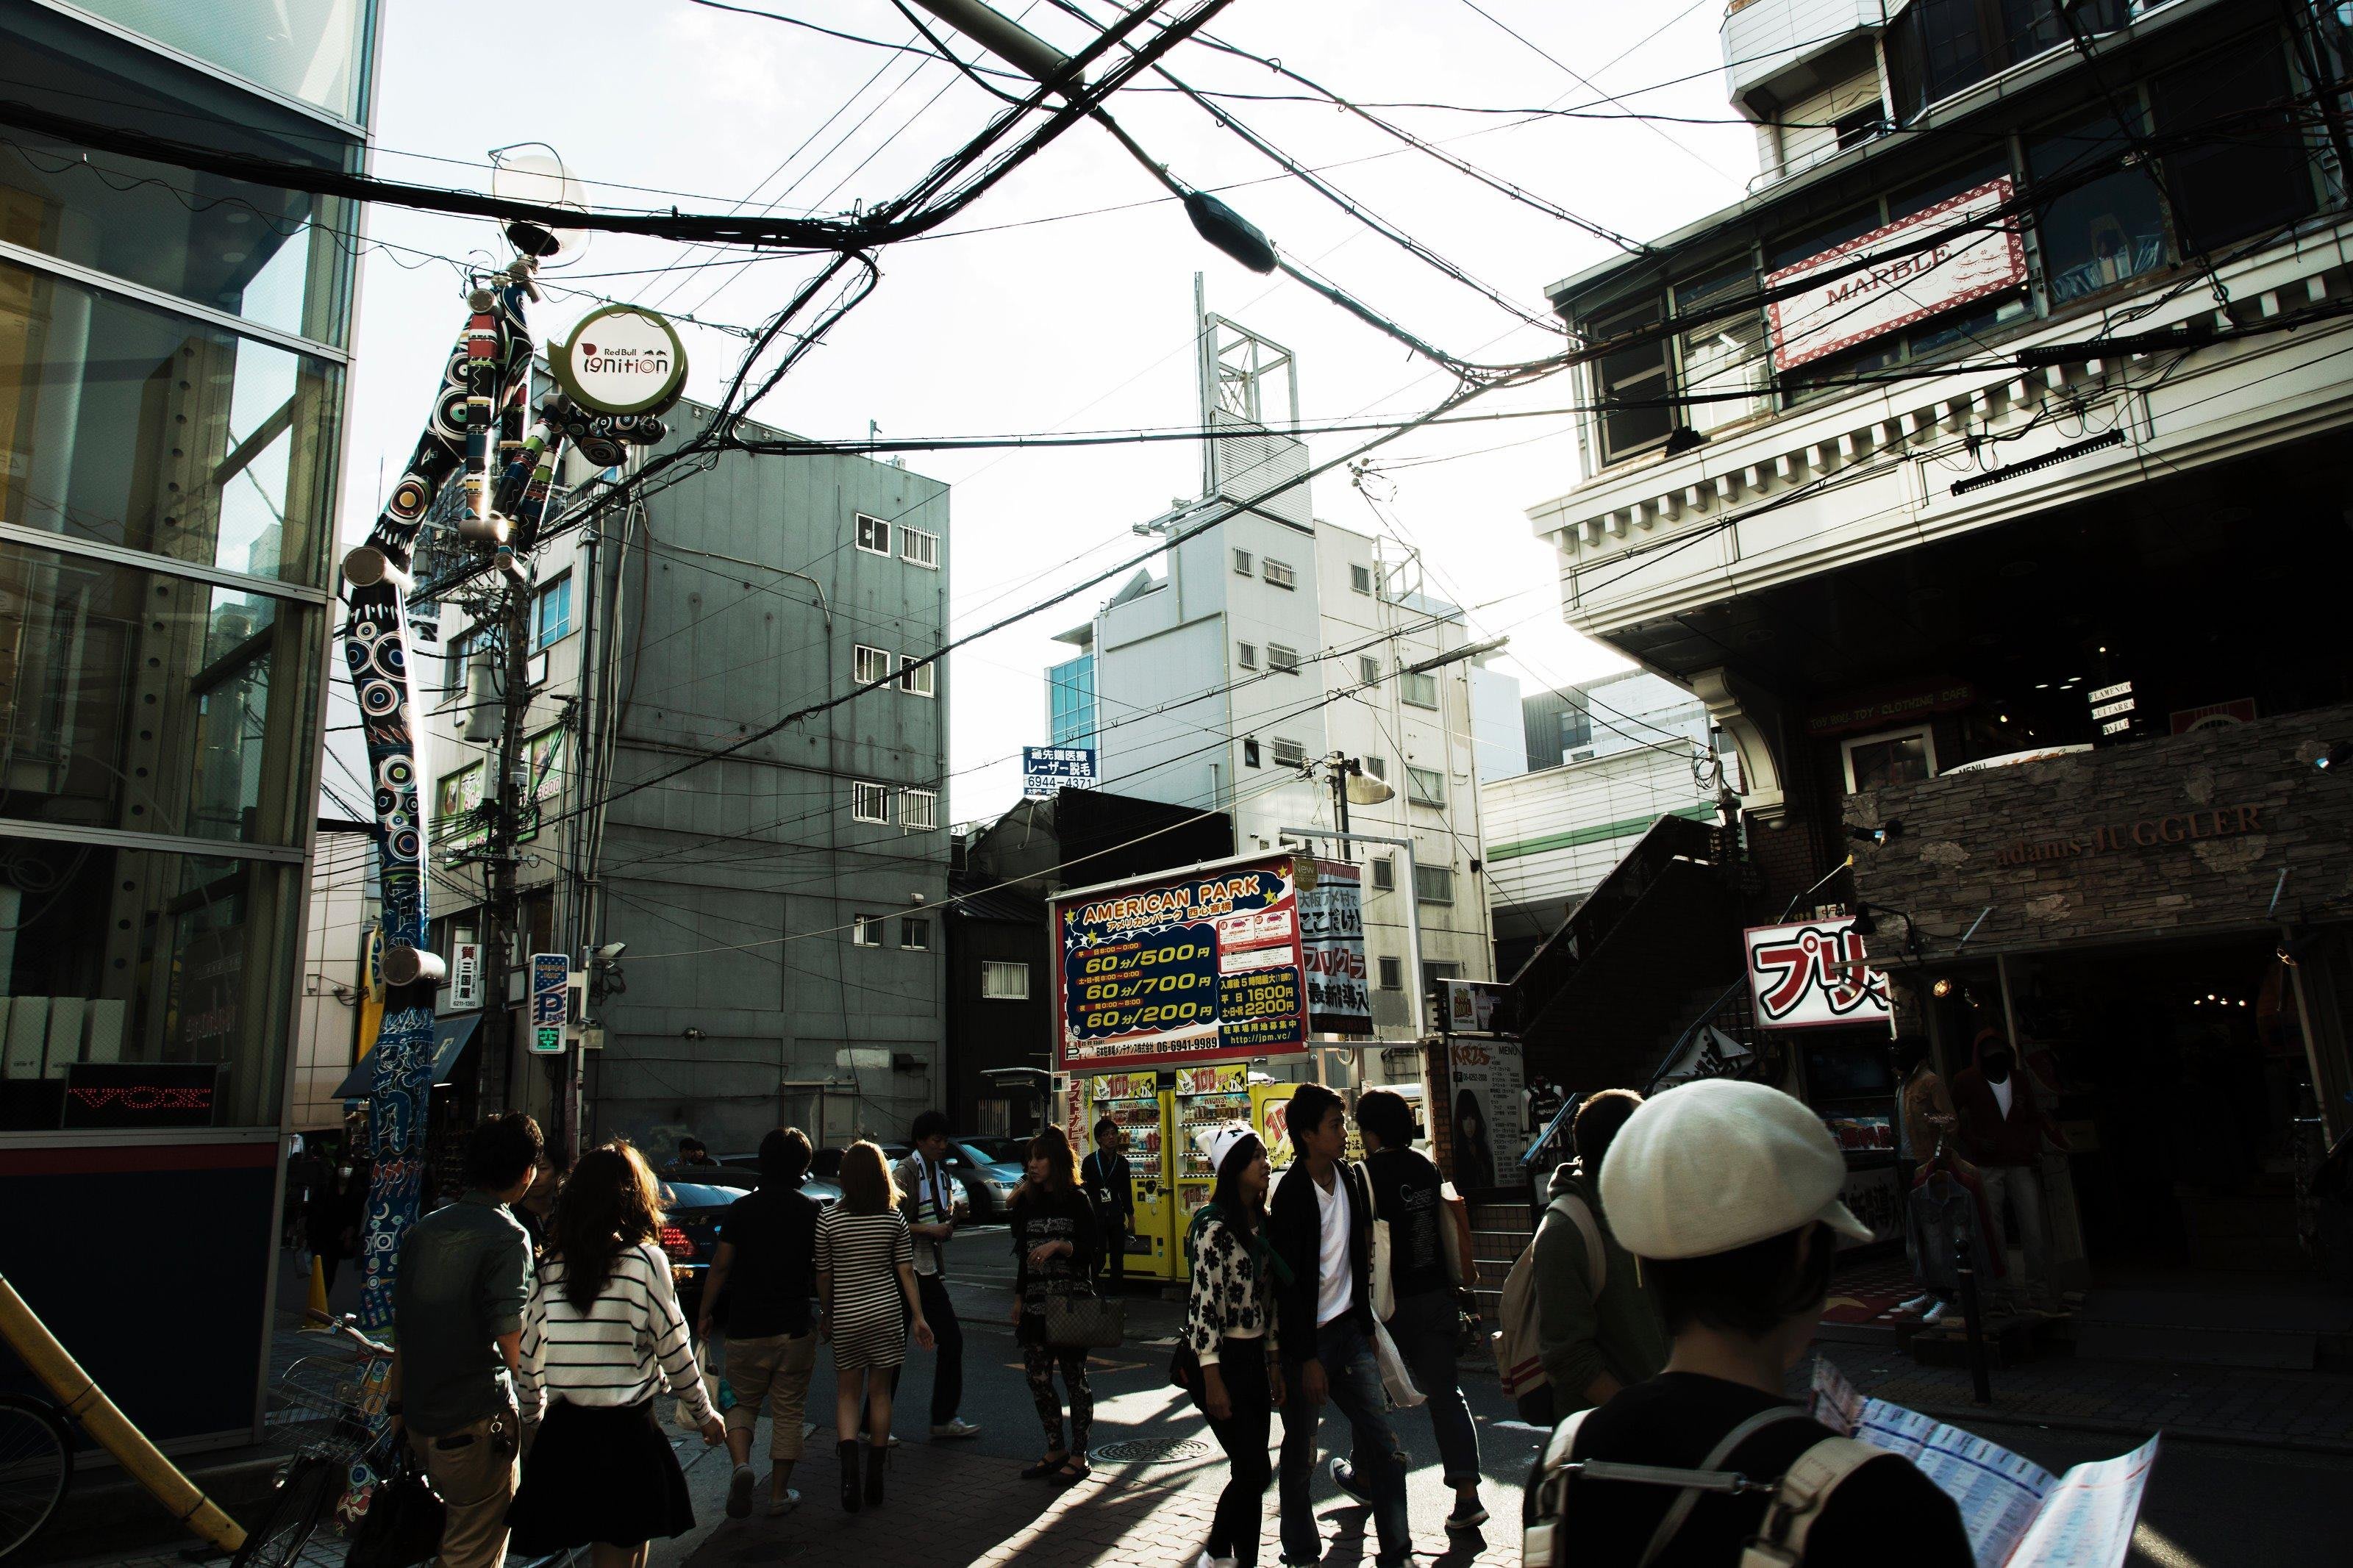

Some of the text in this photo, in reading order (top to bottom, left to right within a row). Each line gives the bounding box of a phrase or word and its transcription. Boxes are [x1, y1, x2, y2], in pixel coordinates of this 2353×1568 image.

[1825, 243, 1953, 307] MARBLE
[584, 357, 668, 373] ignition
[1028, 759, 1091, 776] レーザー脱毛
[2092, 806, 2262, 853] JUGGLER
[1082, 876, 1260, 925] AMERICAN PARK
[1107, 910, 1183, 932] アメリカンパーク
[1753, 927, 1888, 1020] プリ
[539, 993, 564, 1021] P
[538, 1028, 558, 1049] 空
[1157, 1037, 1218, 1053] 06-6941-9989
[1230, 1031, 1291, 1044] http://jpm.vc/
[1265, 1106, 1288, 1142] 10
